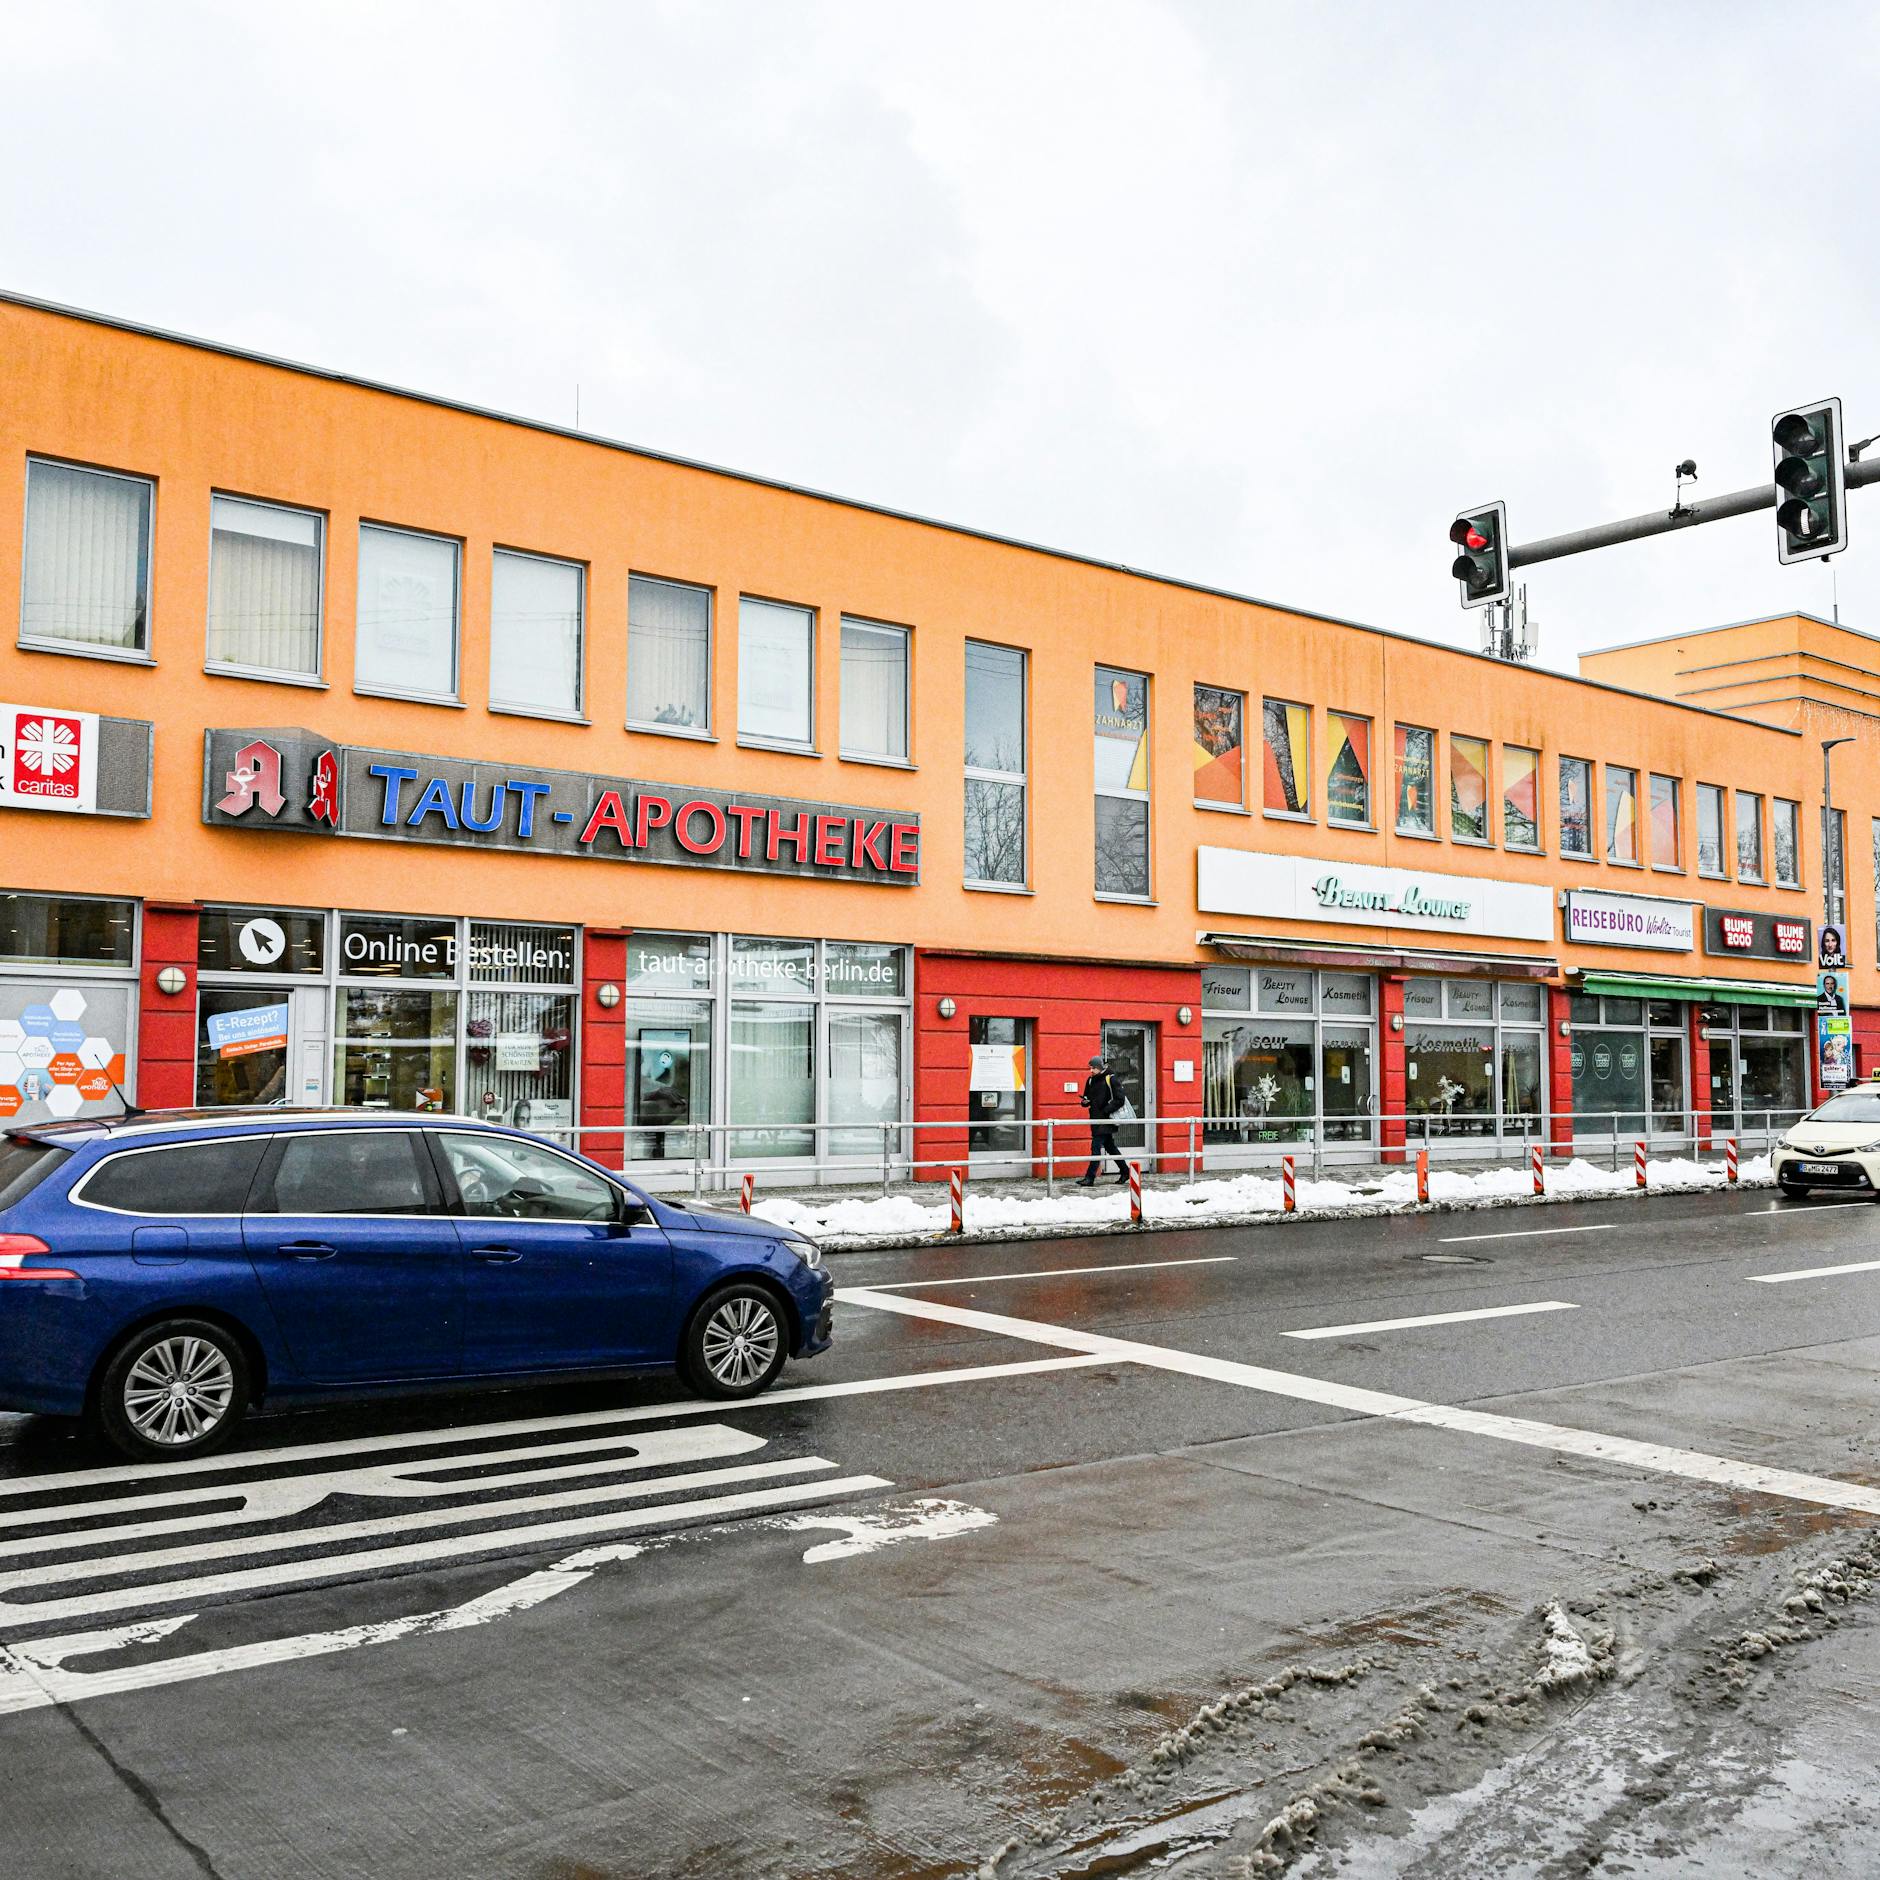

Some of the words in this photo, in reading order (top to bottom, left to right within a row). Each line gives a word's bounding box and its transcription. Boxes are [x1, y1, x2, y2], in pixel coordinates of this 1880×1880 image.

[1095, 714, 1144, 731] ZAHNARZT
[1394, 763, 1430, 779] ZAHNARZT
[18, 778, 75, 797] caritas
[579, 790, 920, 873] APOTHEKE
[1572, 908, 1643, 933] REISEBÜRO
[1672, 926, 1692, 938] Tourist
[1724, 917, 1753, 933] BLUME
[1727, 932, 1752, 948] 2000
[1777, 924, 1804, 940] BLUME
[344, 933, 438, 963] Online
[446, 939, 571, 970] Bestellen:
[1779, 938, 1803, 952] 2000
[1819, 953, 1845, 967] Volt
[1203, 981, 1242, 996] Friseur
[1322, 987, 1367, 1001] Kosmetik
[216, 1010, 279, 1031] E-Rezept?
[218, 1033, 230, 1042] Bei
[232, 1031, 246, 1040] uns
[1409, 1033, 1480, 1054] Kosmetik
